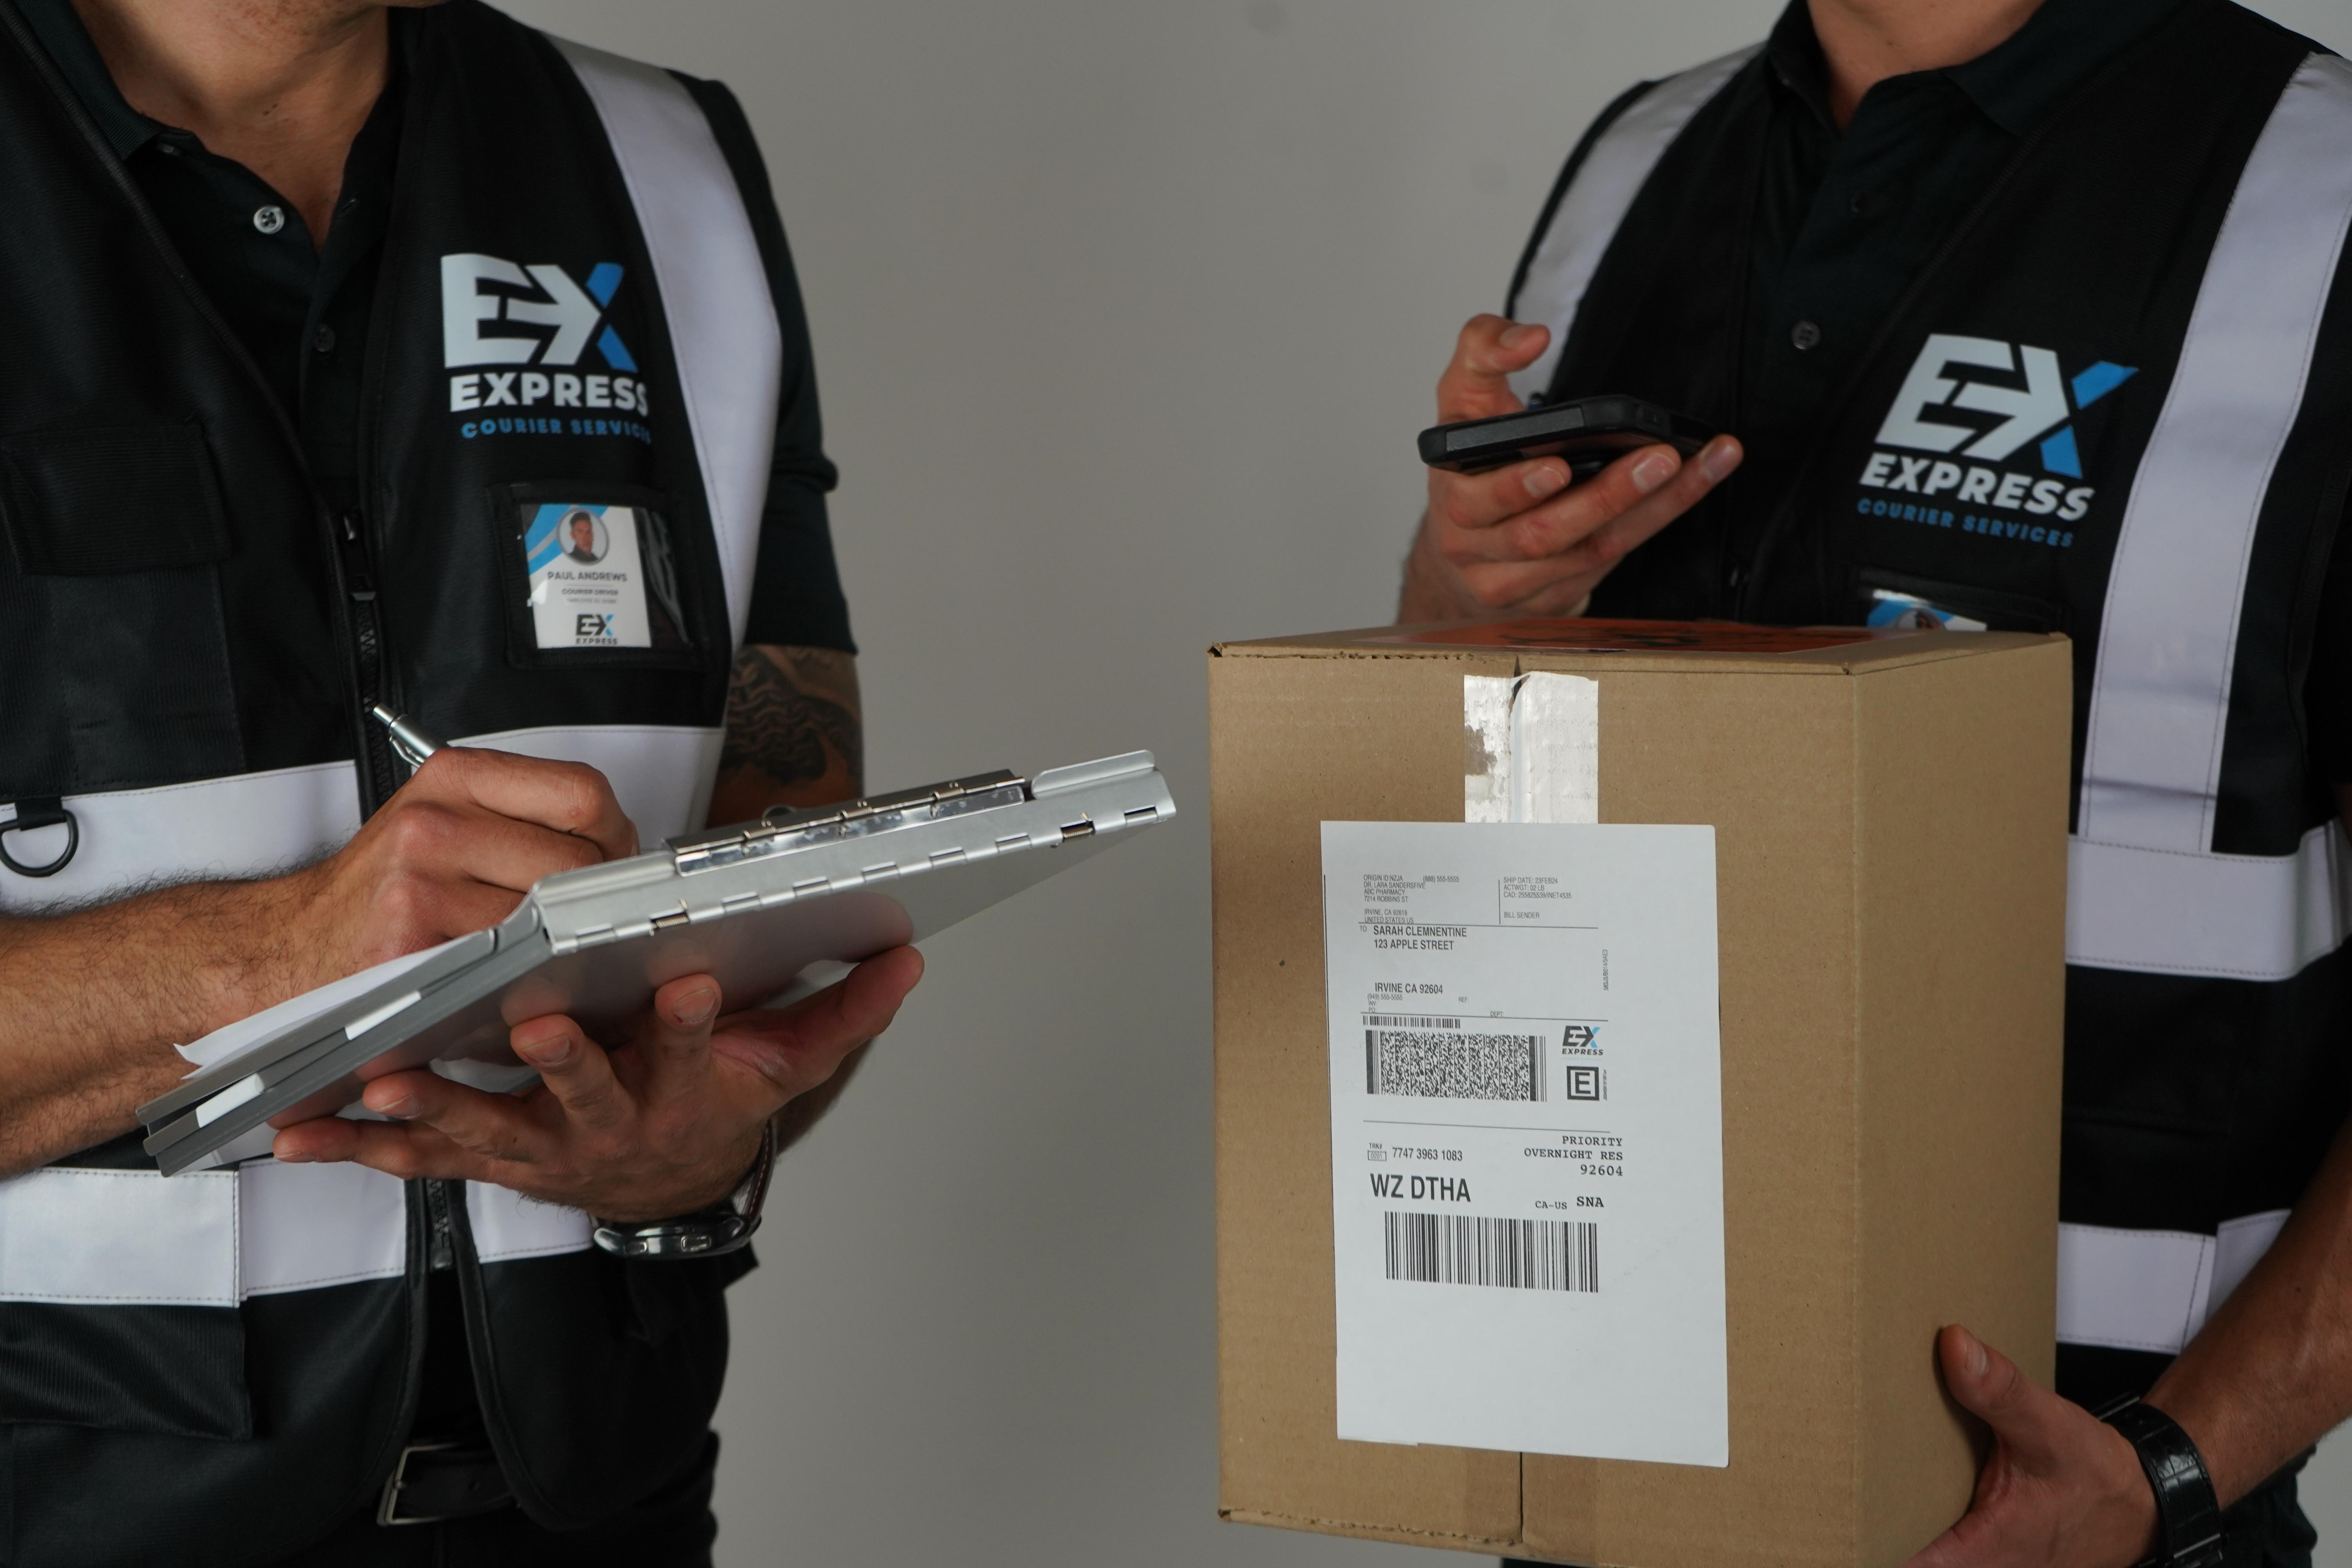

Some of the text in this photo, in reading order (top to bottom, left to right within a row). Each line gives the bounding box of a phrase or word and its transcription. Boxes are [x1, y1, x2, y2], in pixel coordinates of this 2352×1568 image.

[450, 372, 648, 417] EXPRESS
[461, 417, 561, 439] COURIER
[1859, 452, 2095, 521] EXPRESS
[1857, 498, 2074, 547] COURIER SERVICES
[548, 571, 628, 582] PAUL ANDREWS
[1373, 925, 1467, 937] SARAH CLEMNENTINE
[1374, 939, 1454, 950] 123 APPLE STREET
[1375, 982, 1443, 994] IRVINE CA 92604
[1575, 1072, 1591, 1094] E
[1562, 1136, 1623, 1146] PRIORITY
[1392, 1147, 1463, 1161] 7747 3963 1083
[1524, 1148, 1623, 1160] OVERNIGHT RES
[1581, 1164, 1623, 1176] 92604
[1370, 1173, 1471, 1203] WZ DTHA
[1535, 1196, 1604, 1210] CA-US SNA
